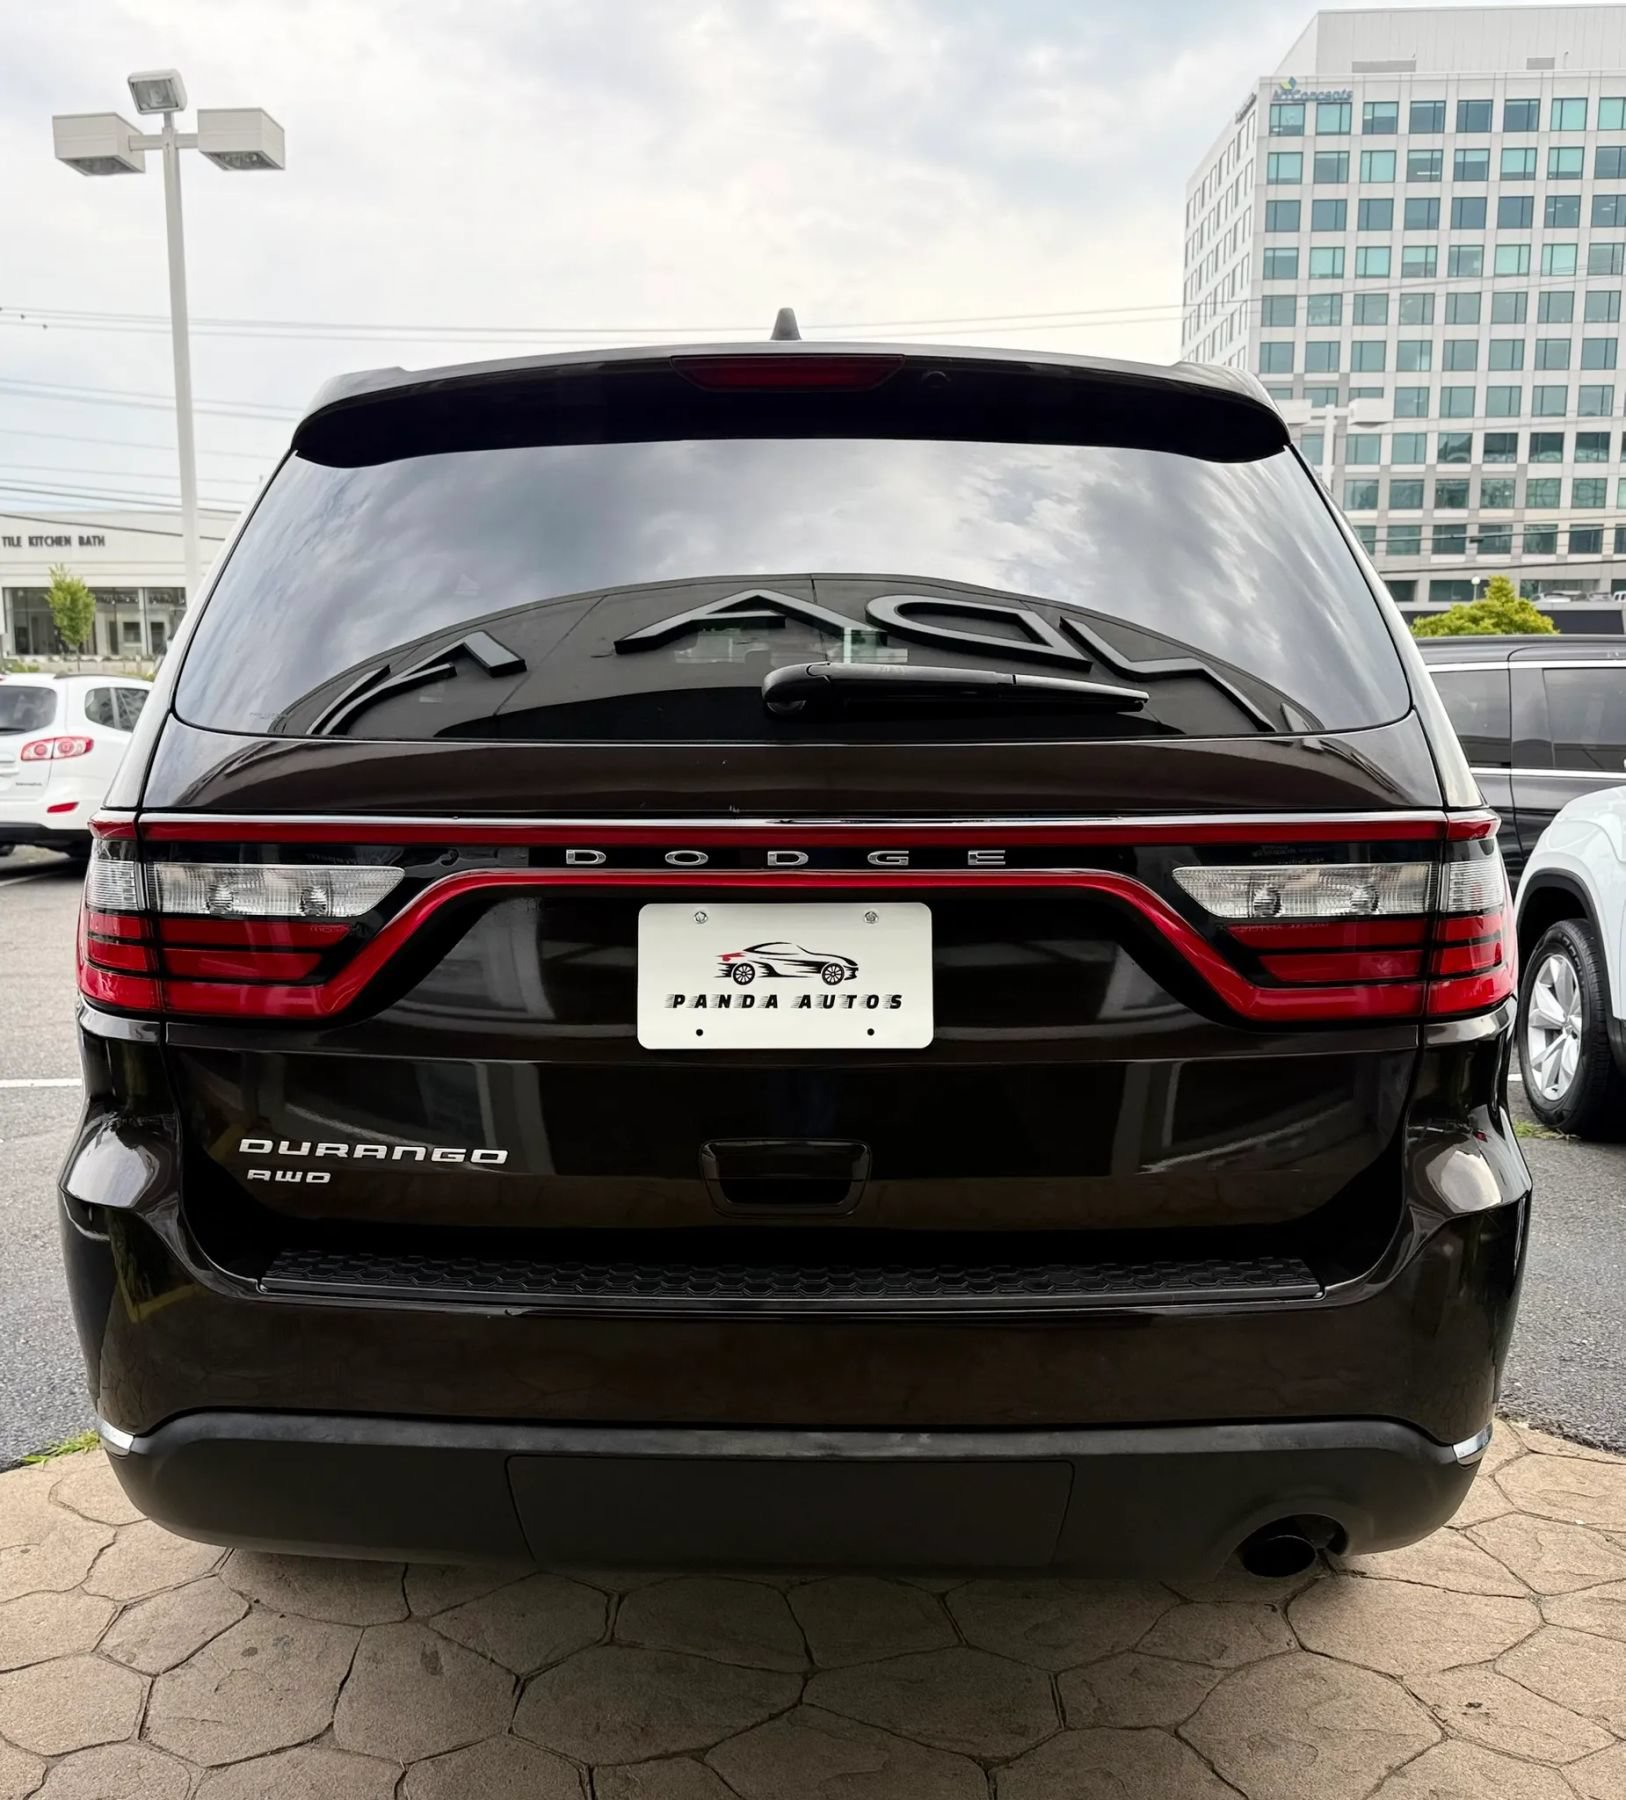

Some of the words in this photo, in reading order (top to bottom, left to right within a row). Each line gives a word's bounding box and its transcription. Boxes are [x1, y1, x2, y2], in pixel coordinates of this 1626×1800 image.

[1, 535, 22, 548] TILE
[28, 535, 71, 548] KITCHEN
[78, 535, 105, 547] BATH
[566, 849, 1006, 866] DODGE
[665, 993, 778, 1009] PANDA
[791, 993, 902, 1009] AUTOS
[239, 1138, 509, 1165] DURANGO
[247, 1169, 331, 1184] AWD
